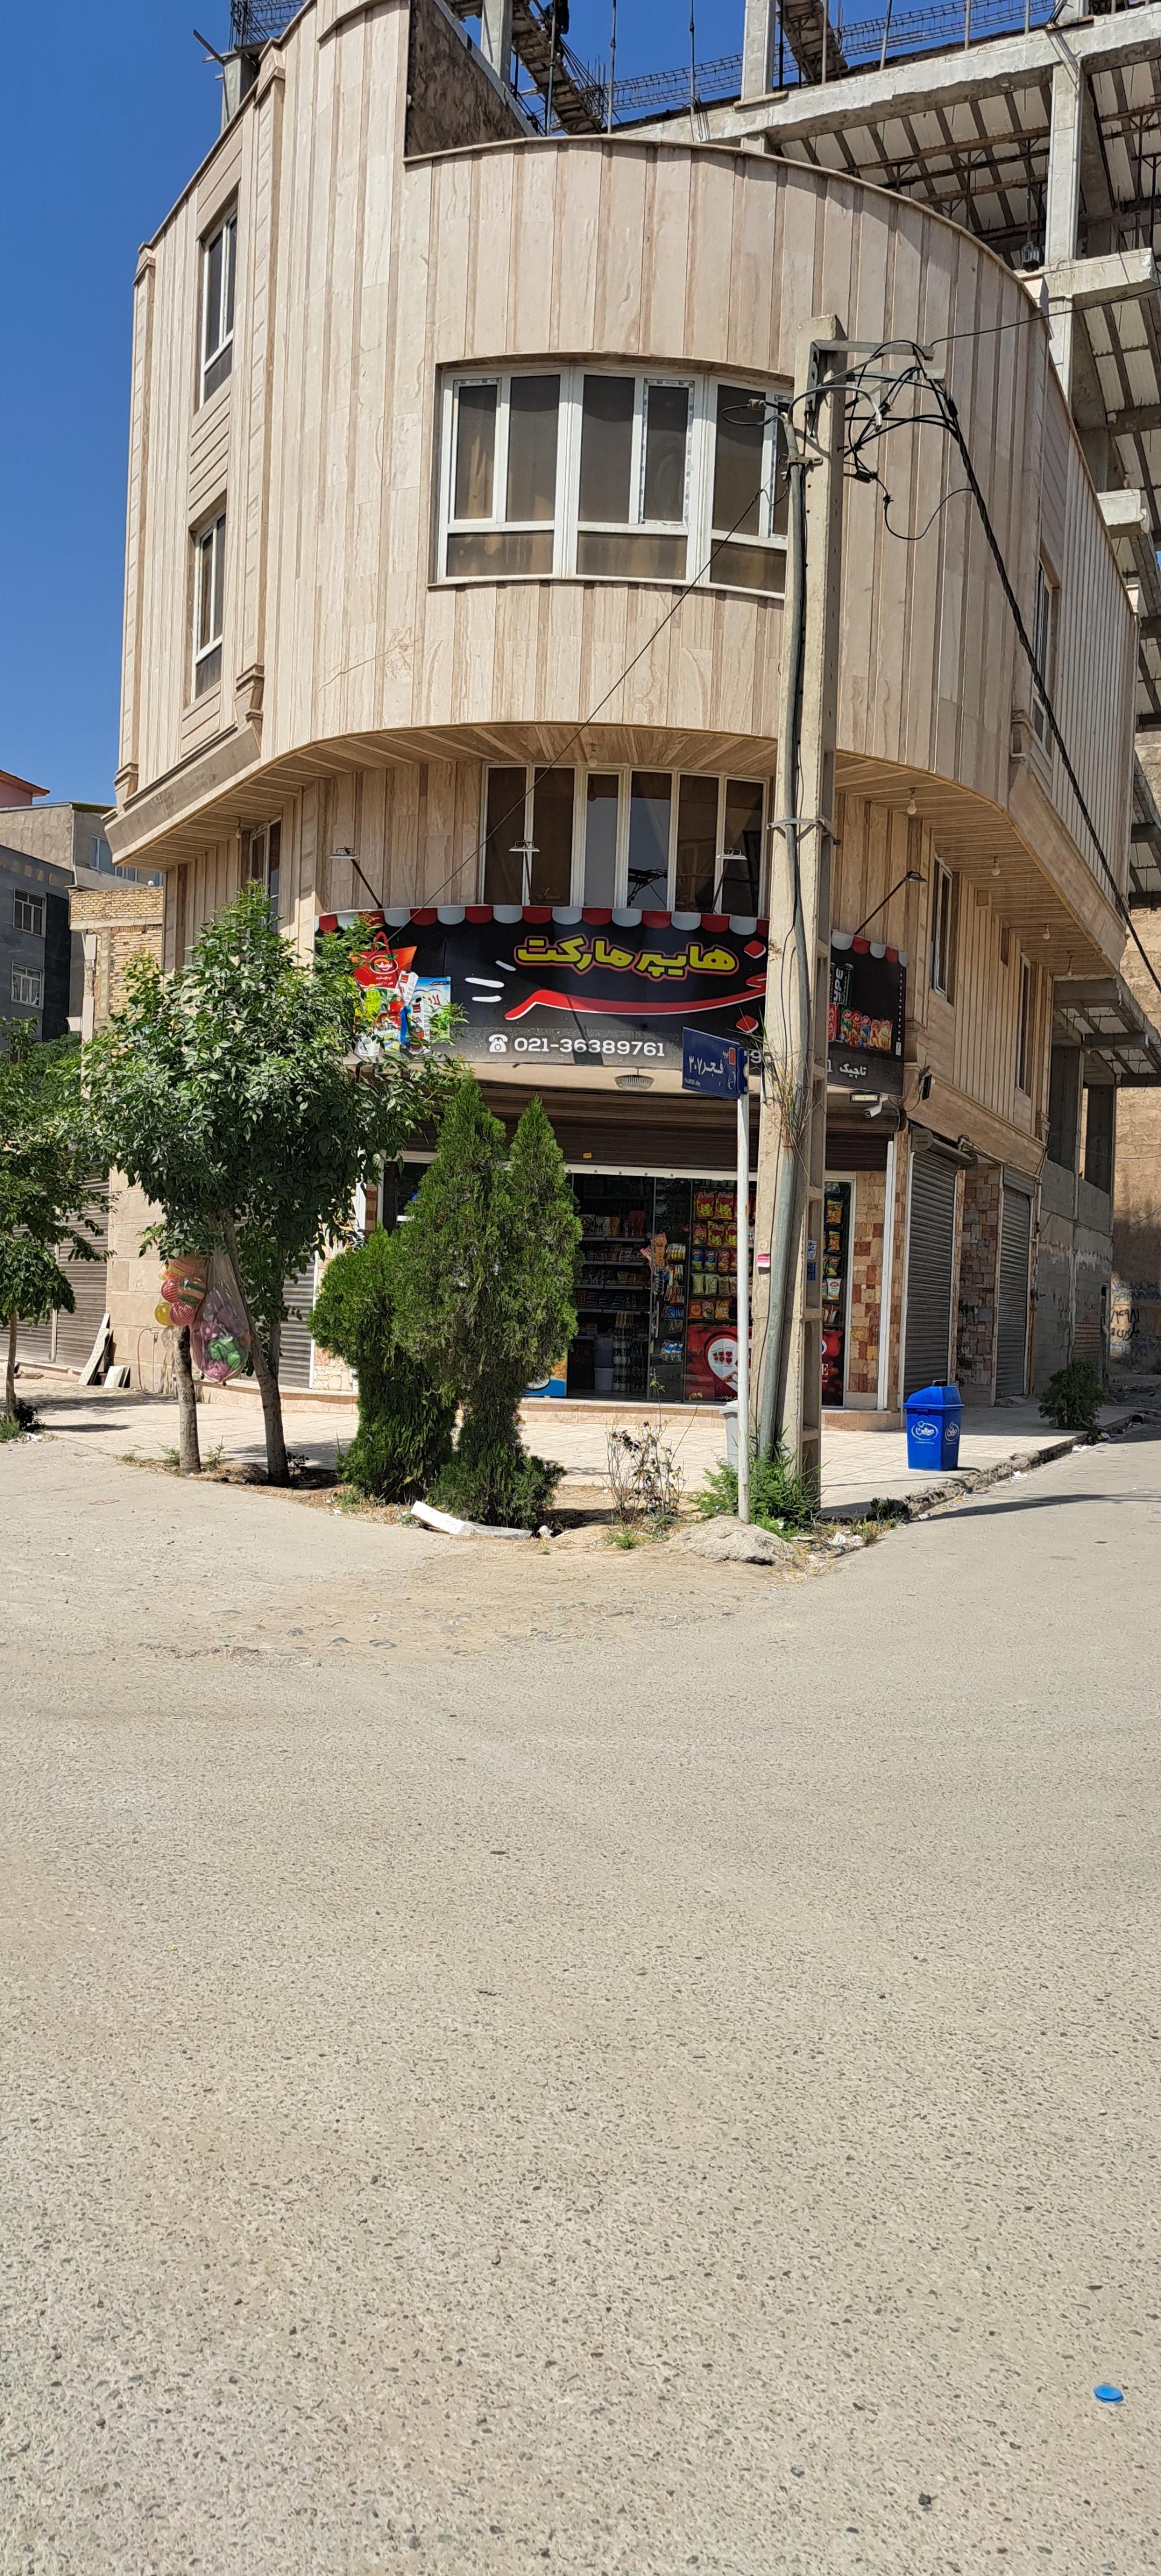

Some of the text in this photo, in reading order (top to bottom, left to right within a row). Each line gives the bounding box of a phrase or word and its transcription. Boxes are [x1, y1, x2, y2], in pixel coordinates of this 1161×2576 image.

[516, 937, 737, 978] هایپر مارکت
[514, 1037, 665, 1056] 021-36389761
[839, 1063, 867, 1080] تاجیک
